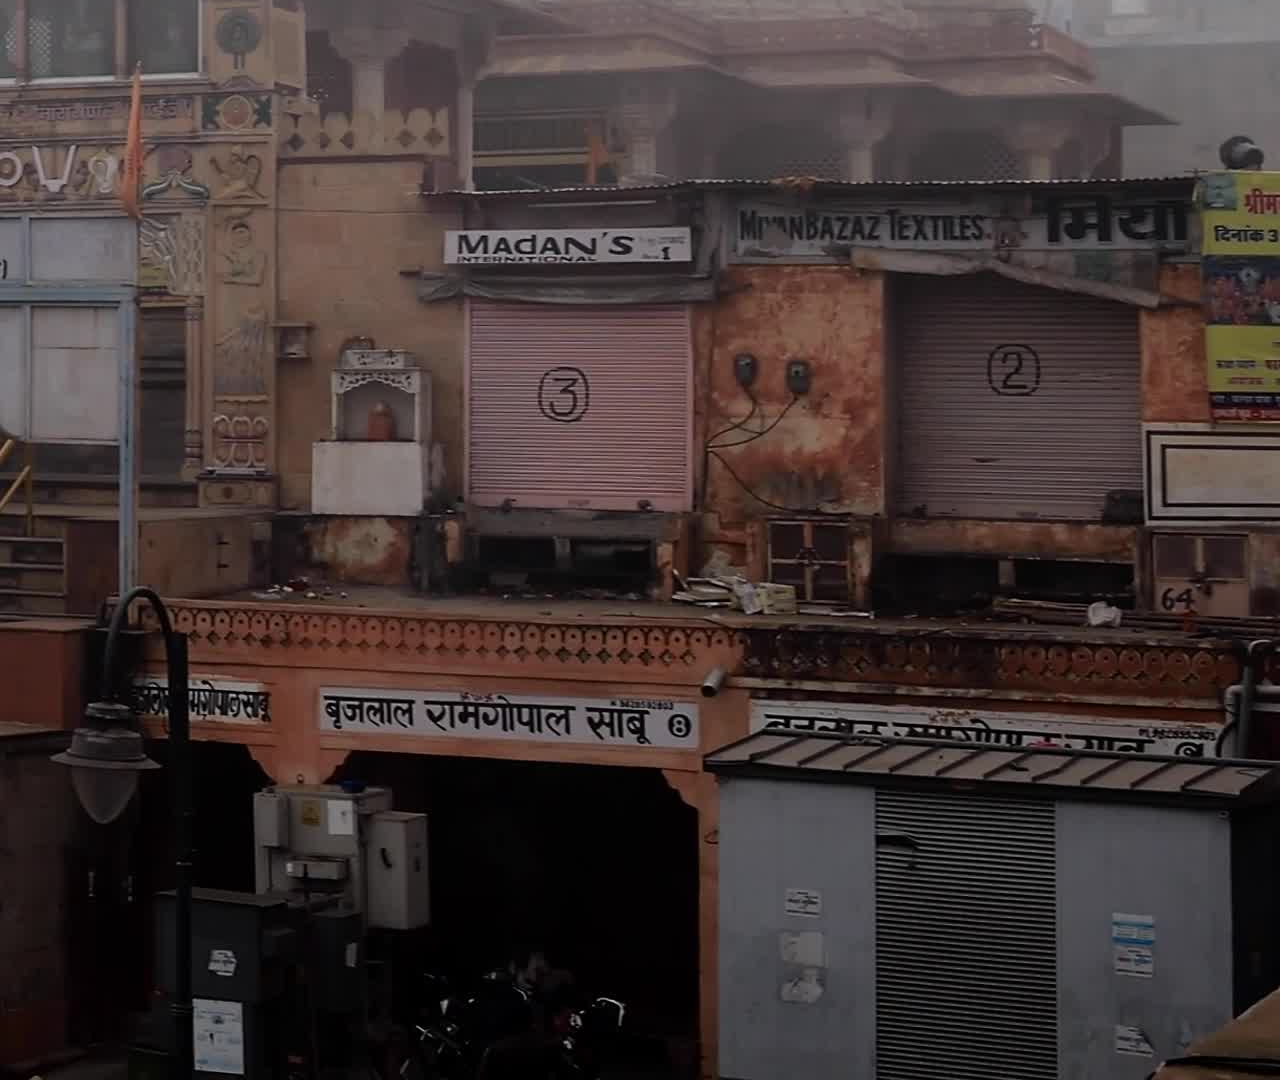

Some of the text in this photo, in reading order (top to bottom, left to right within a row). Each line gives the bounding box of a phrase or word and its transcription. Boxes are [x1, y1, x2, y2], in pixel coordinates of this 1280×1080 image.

[885, 209, 984, 241] TEXTILES
[1214, 225, 1264, 242] दिनांक
[457, 255, 598, 263] INTERNATIONAL
[1002, 352, 1027, 389] 2
[549, 378, 580, 415] 3
[1162, 588, 1194, 611] 64
[324, 695, 651, 744] बृजलाल रामगोपाल साबू
